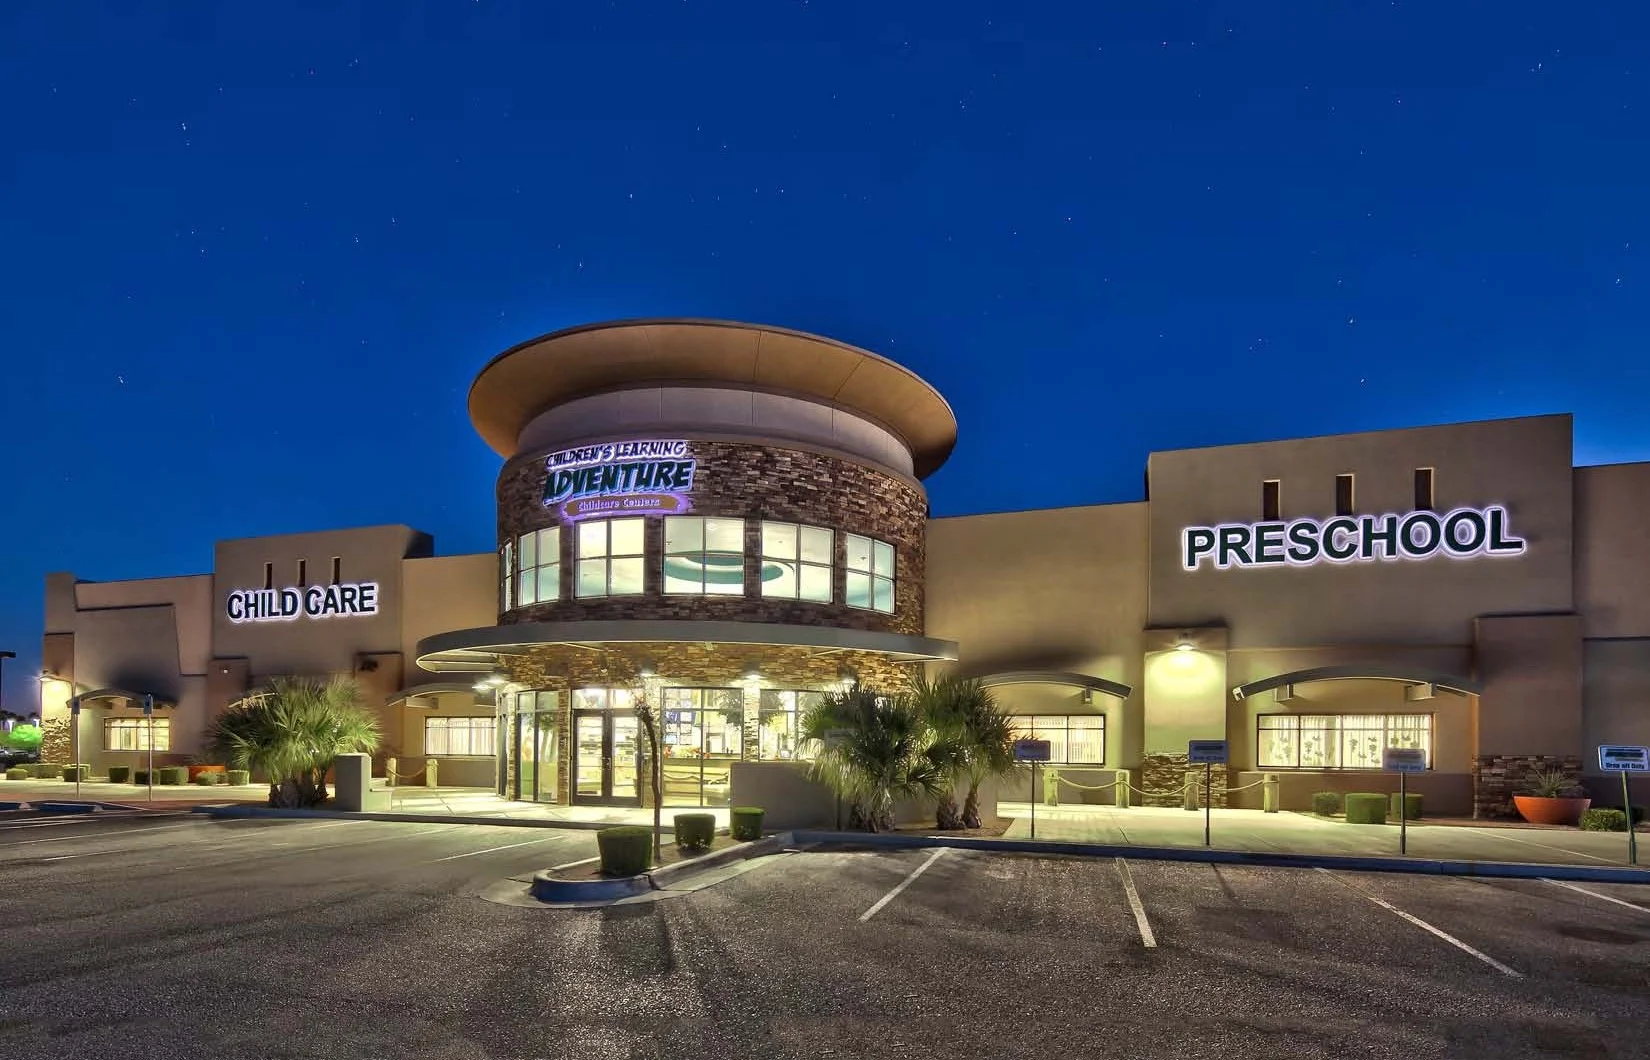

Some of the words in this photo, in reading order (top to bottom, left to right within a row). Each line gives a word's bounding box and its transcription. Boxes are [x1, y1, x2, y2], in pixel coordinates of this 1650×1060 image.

[546, 445, 613, 468] CHILDREN'S
[615, 441, 686, 459] LEARNING
[543, 460, 695, 504] ADVENTURE
[1186, 509, 1524, 567] PRESCHOOL
[227, 590, 298, 619] CHILD
[304, 585, 376, 615] CARE
